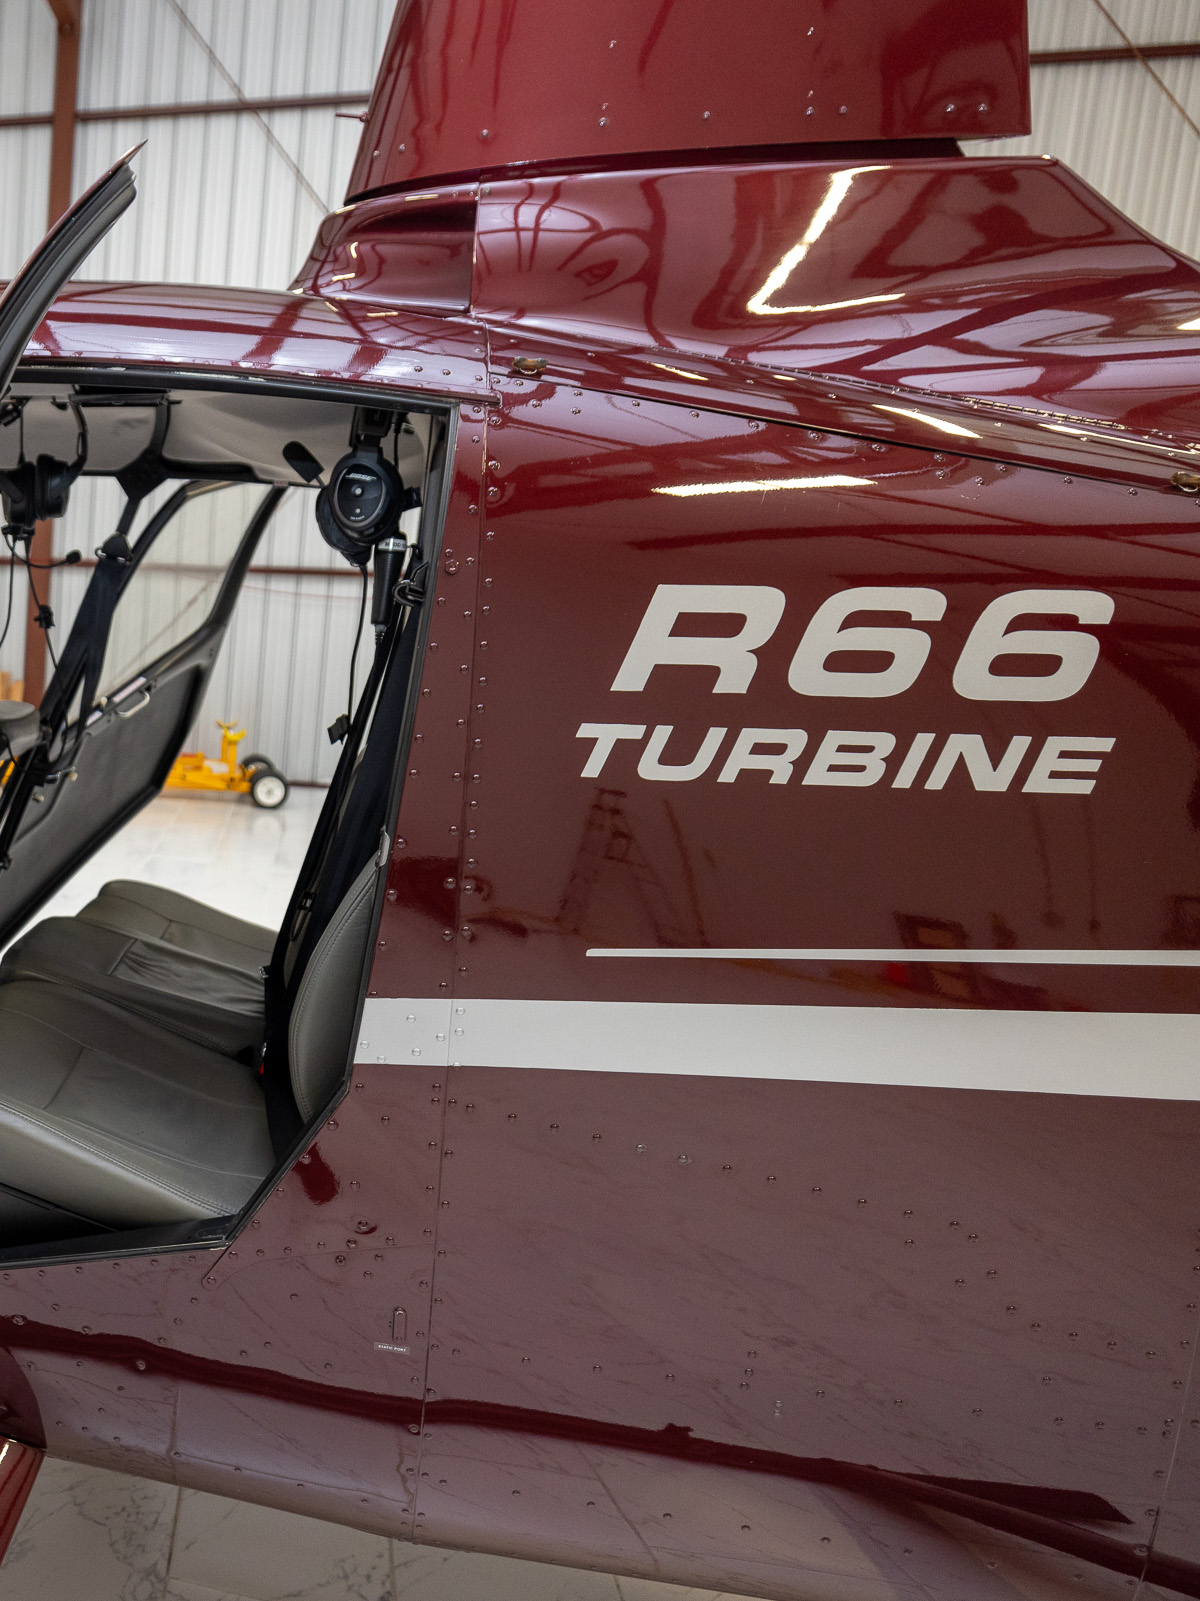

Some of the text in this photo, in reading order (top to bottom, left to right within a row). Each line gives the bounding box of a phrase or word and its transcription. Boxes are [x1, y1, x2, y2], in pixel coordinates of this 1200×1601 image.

[345, 473, 377, 482] BOSE
[610, 584, 1116, 702] R66
[575, 722, 1116, 795] TURBINE
